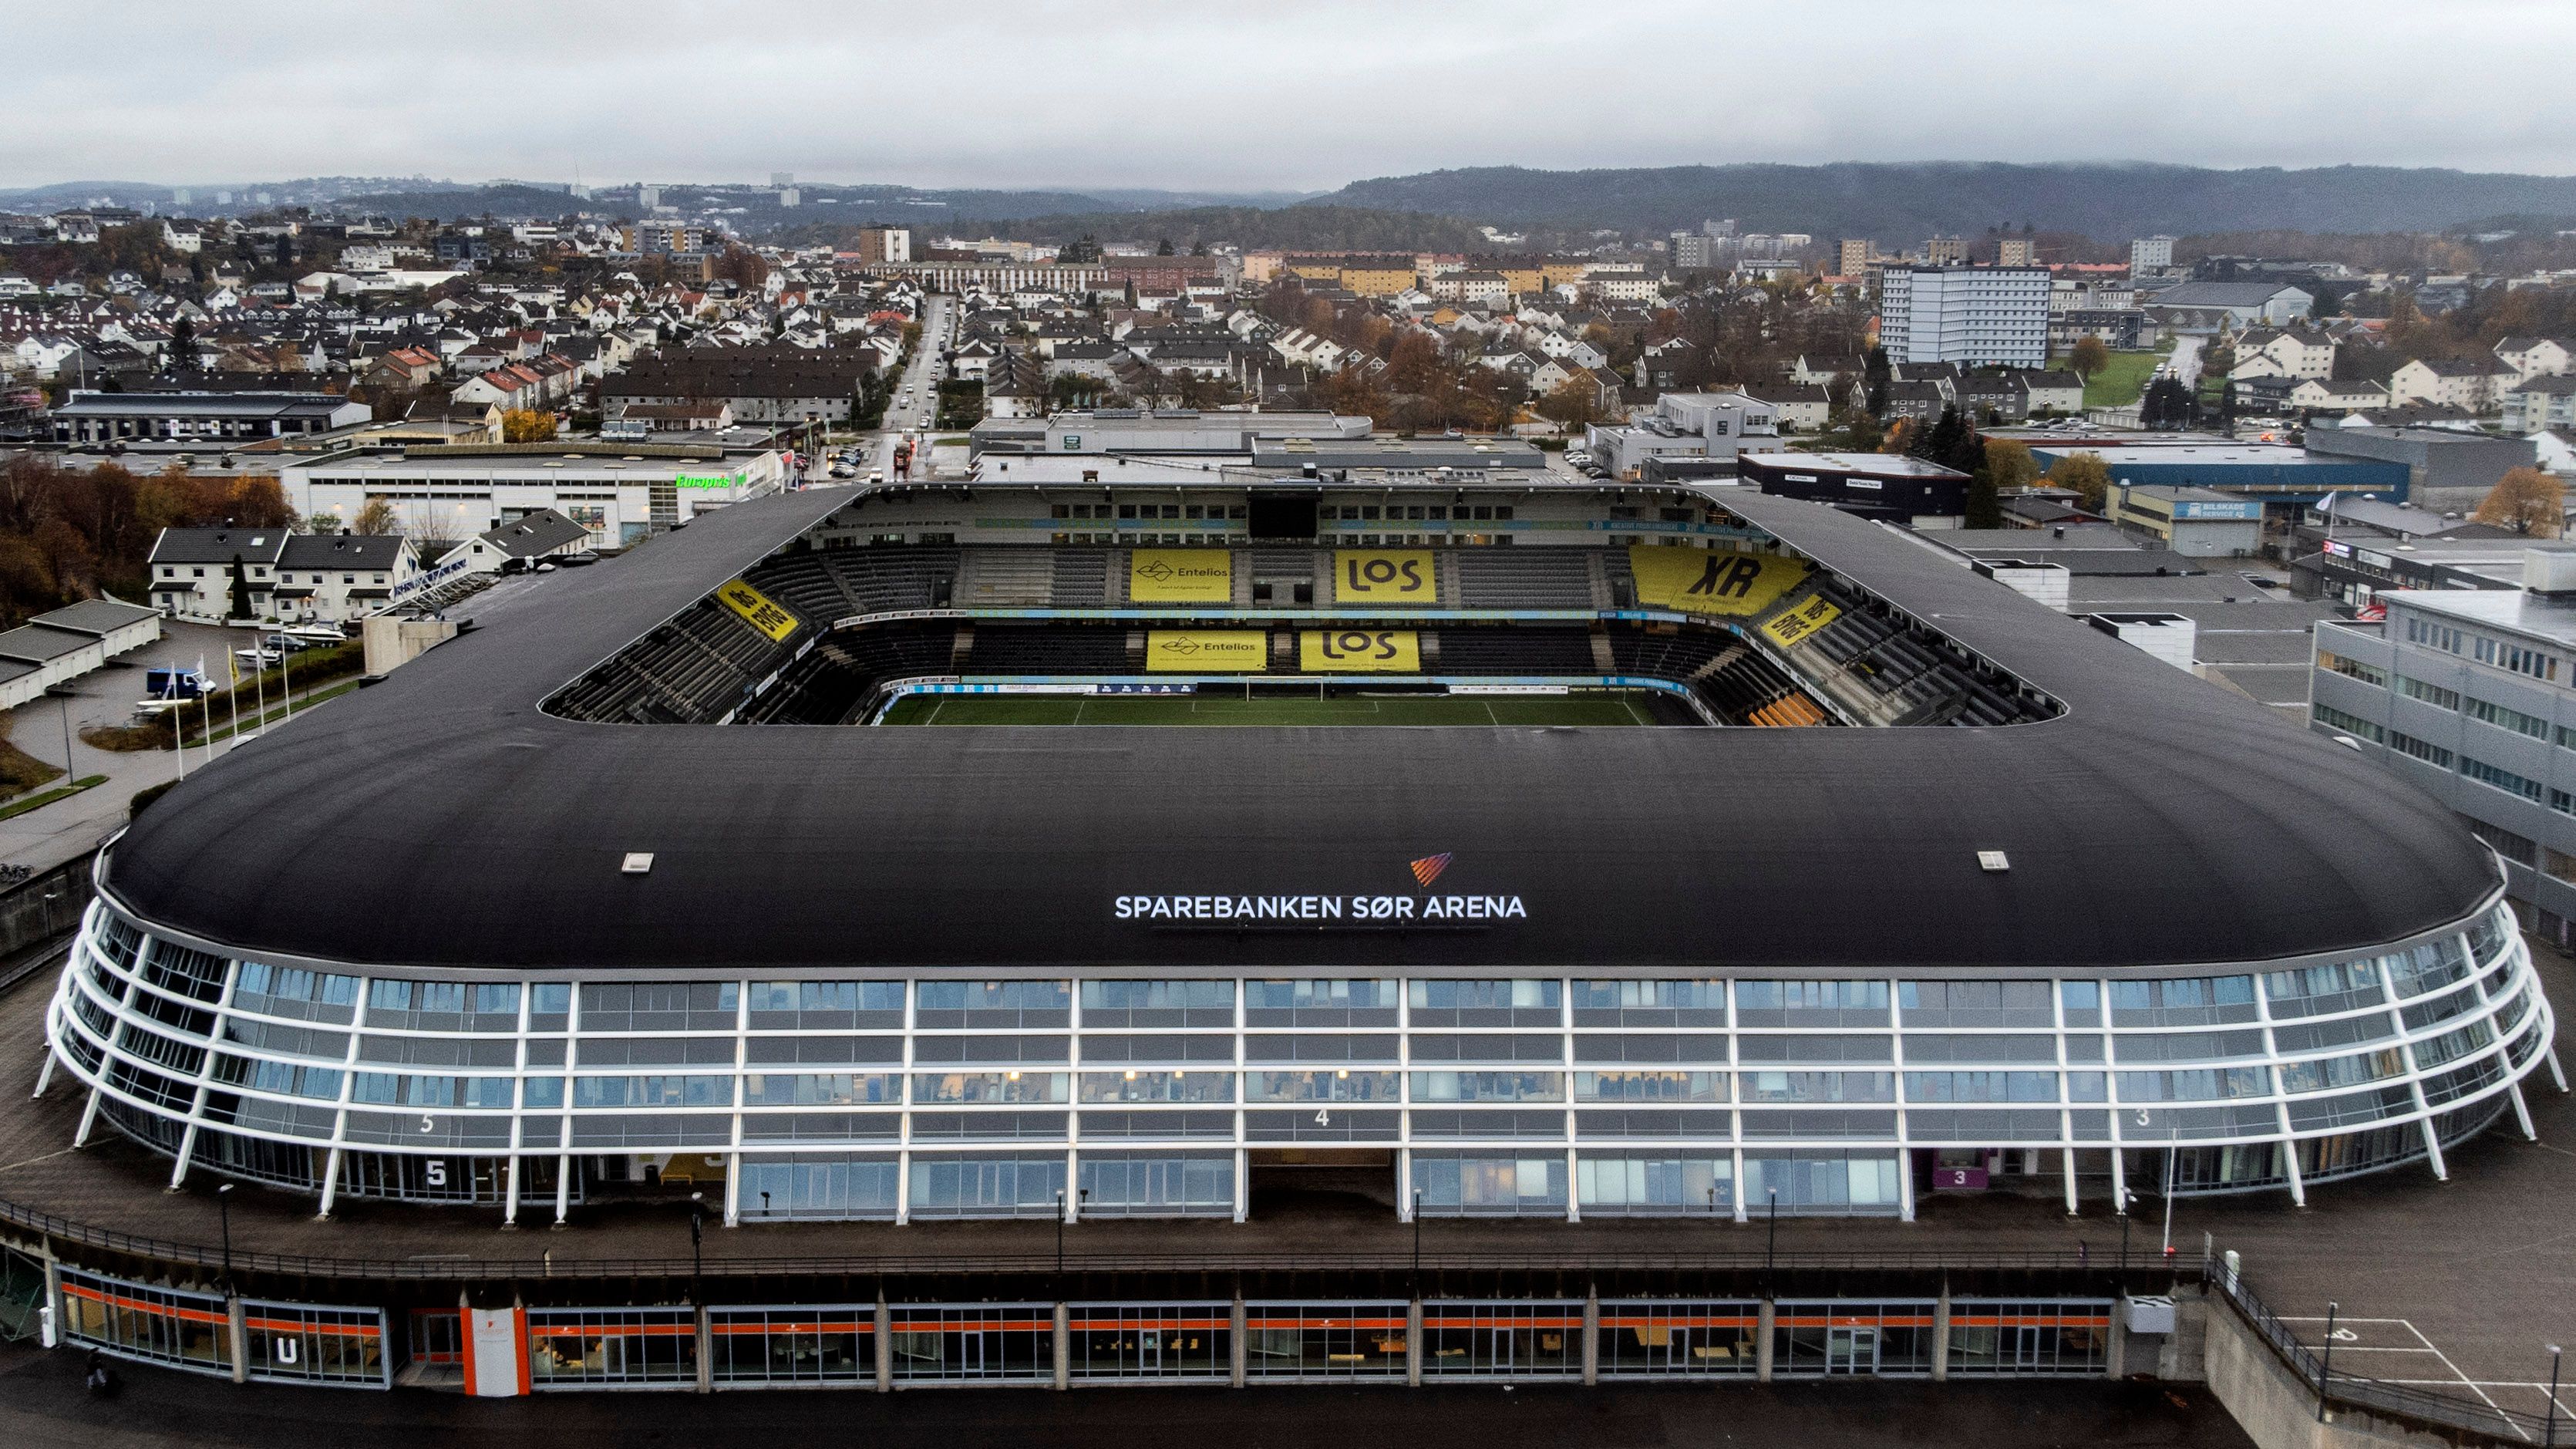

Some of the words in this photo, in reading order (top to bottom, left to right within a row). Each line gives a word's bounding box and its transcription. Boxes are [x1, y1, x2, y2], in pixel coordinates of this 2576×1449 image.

[676, 473, 730, 491] Europris
[1178, 568, 1228, 577] Entelios
[1349, 559, 1422, 591] LOS
[1687, 555, 1762, 598] XR
[752, 604, 789, 632] BYGG
[1771, 614, 1811, 639] BYGG
[1204, 642, 1255, 651] Entelios
[1322, 632, 1397, 659] LOS
[1115, 895, 1342, 919] SPAREBANKEN
[1352, 895, 1414, 919] SØR
[1423, 895, 1527, 919] ARENA
[420, 1112, 433, 1133] 5
[1315, 1107, 1329, 1126] 4
[2137, 1107, 2149, 1126] 3
[427, 1161, 446, 1184] 5
[1955, 1171, 1965, 1184] 3
[278, 1337, 297, 1363] U
